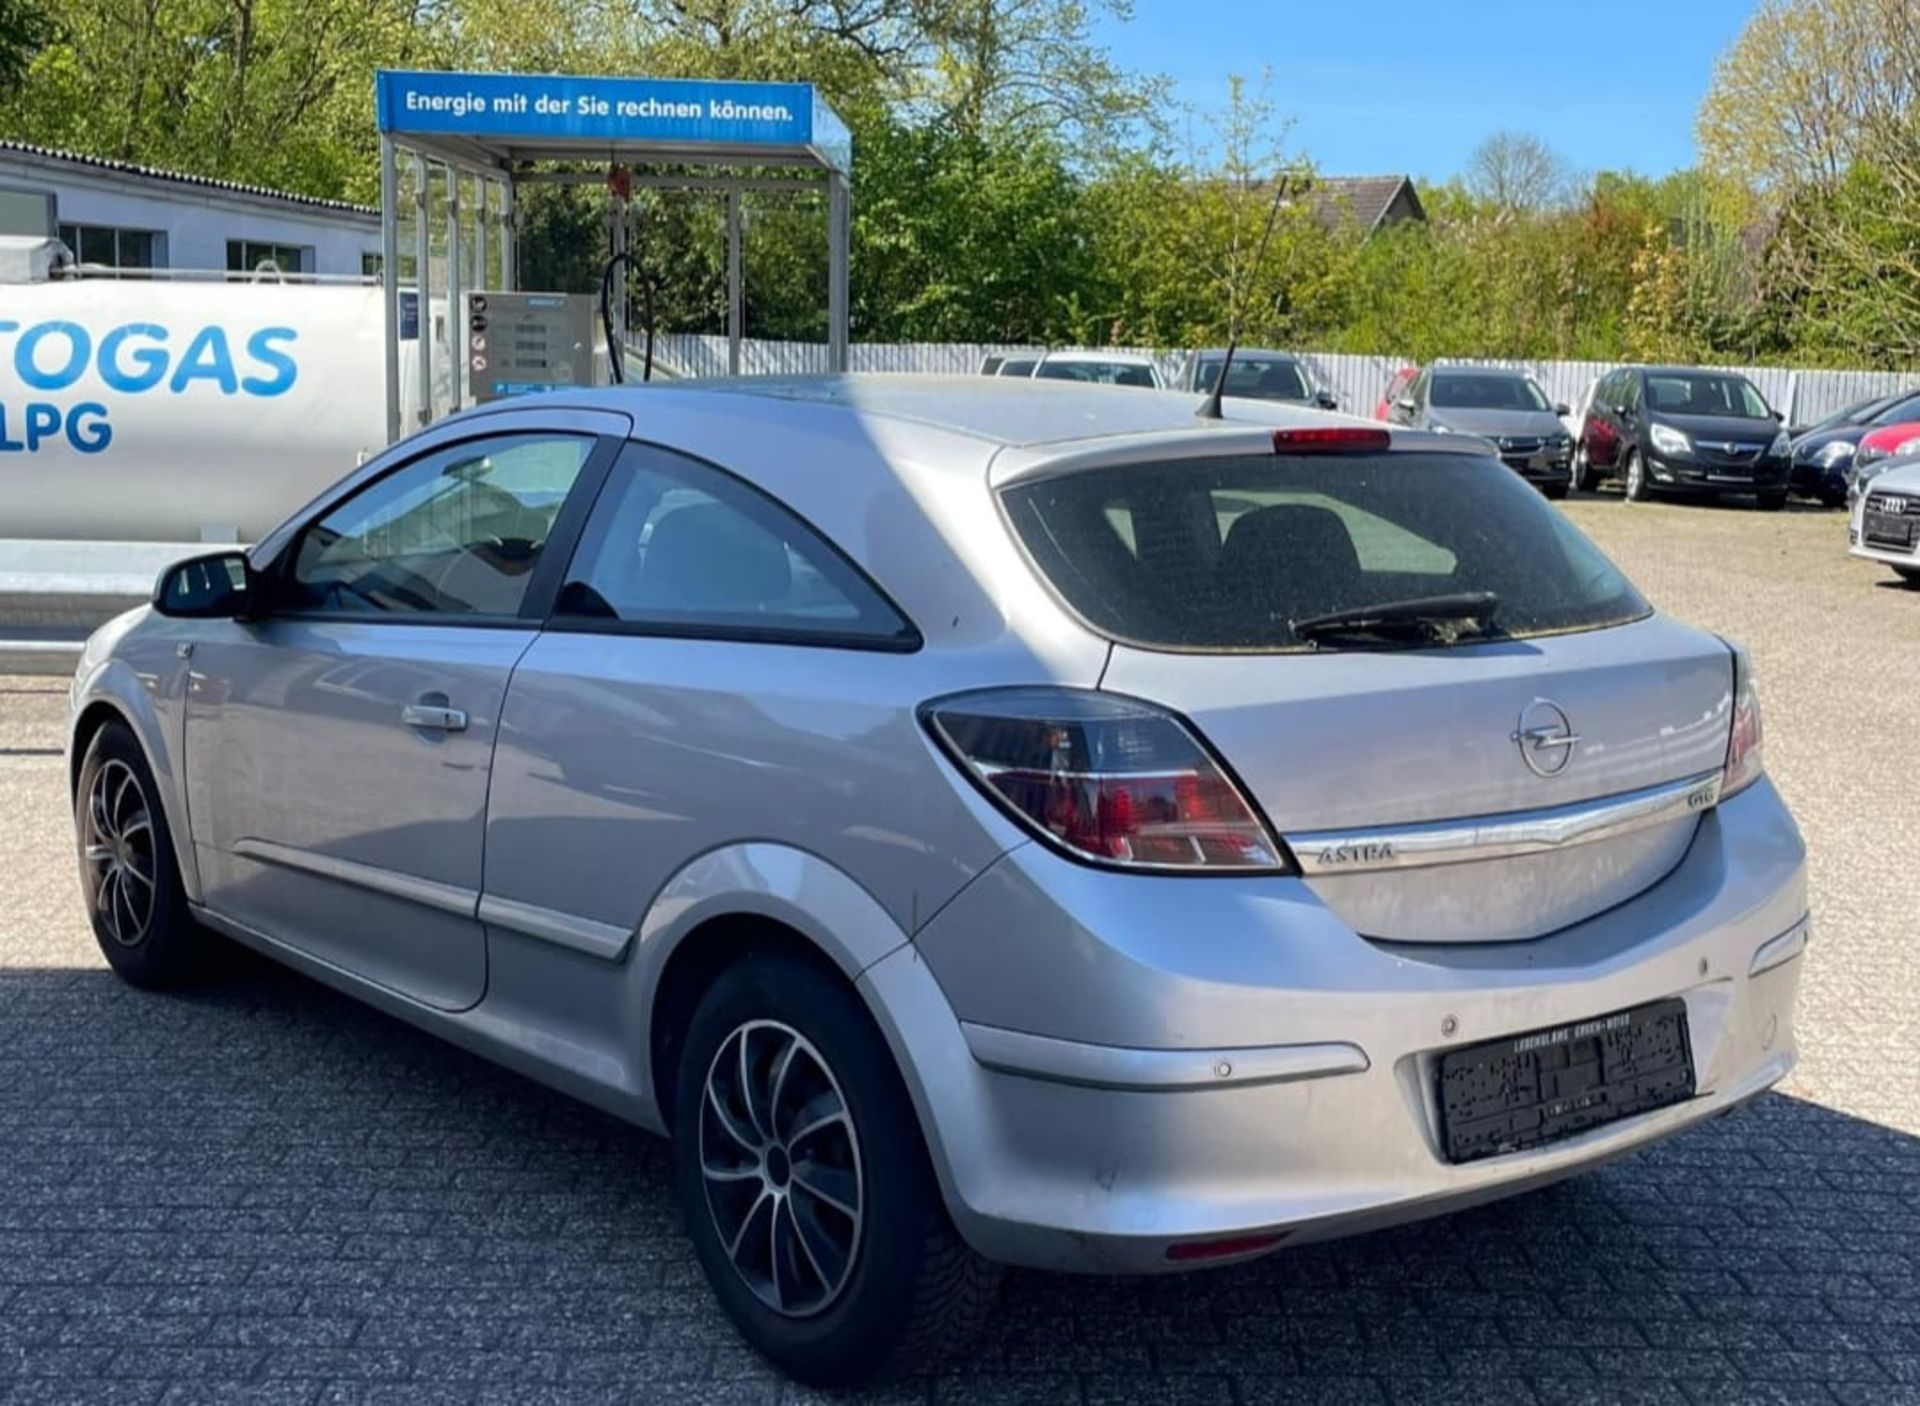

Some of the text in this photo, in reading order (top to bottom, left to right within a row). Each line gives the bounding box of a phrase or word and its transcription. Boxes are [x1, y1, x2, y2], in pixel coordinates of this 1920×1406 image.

[406, 91, 793, 121] Energie mit der Sie rechnen können.
[0, 402, 112, 453] LPG
[1318, 842, 1393, 865] ASTRA
